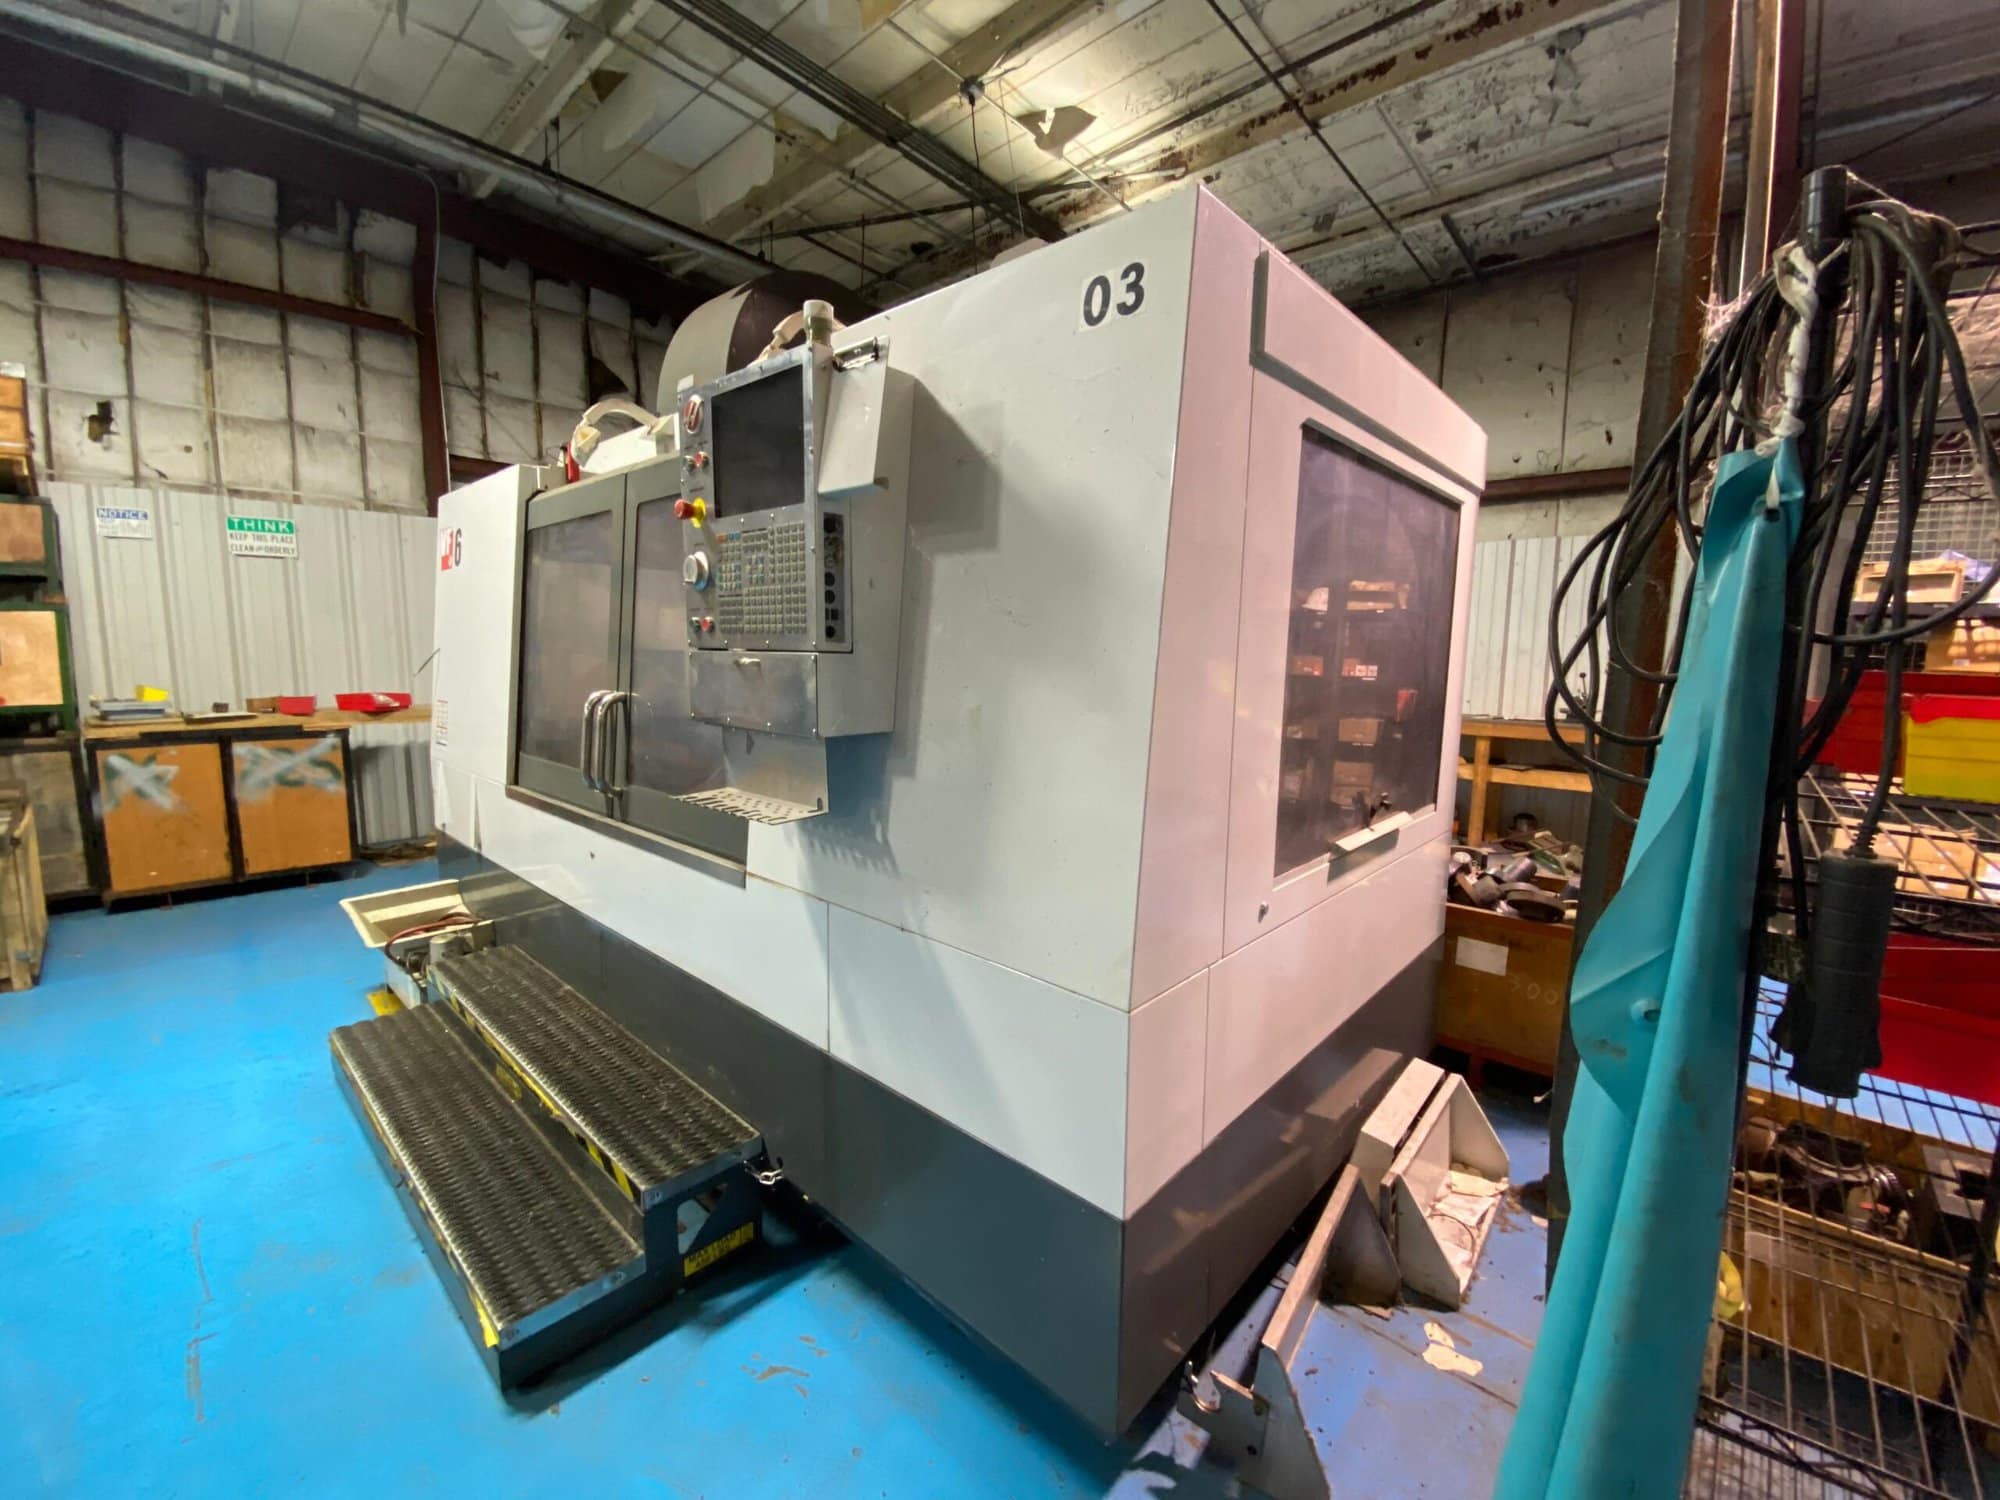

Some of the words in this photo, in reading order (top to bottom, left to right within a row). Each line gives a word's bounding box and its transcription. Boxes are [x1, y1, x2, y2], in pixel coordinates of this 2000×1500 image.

[1083, 261, 1145, 327] 03
[98, 508, 146, 520] NOTICE
[231, 518, 291, 534] THINK
